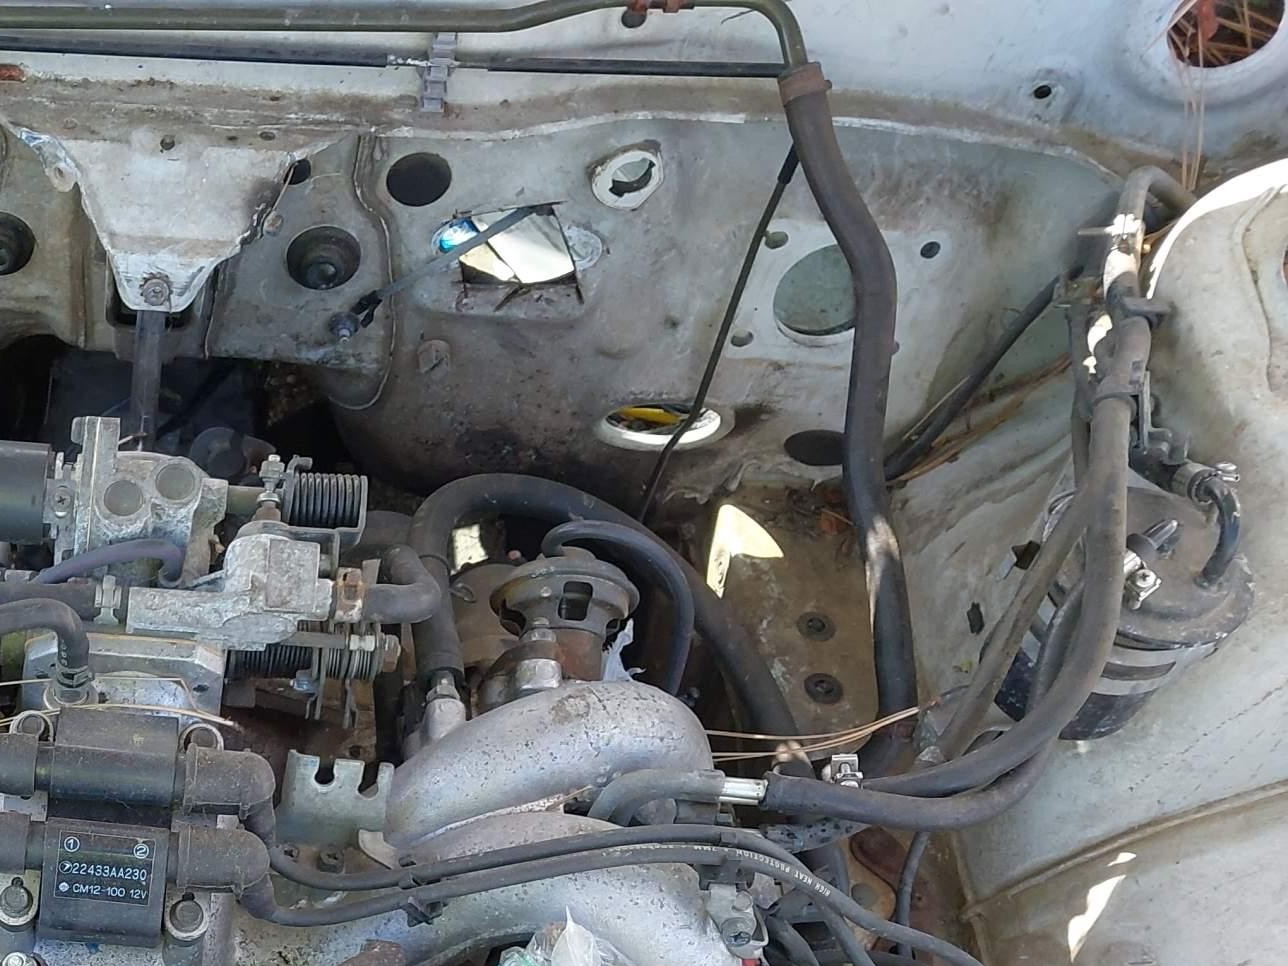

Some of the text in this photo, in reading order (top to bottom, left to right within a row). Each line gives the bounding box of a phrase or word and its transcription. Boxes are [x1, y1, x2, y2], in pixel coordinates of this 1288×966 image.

[72, 863, 147, 881] 22433AA230
[73, 883, 148, 899] CM12-100 12V
